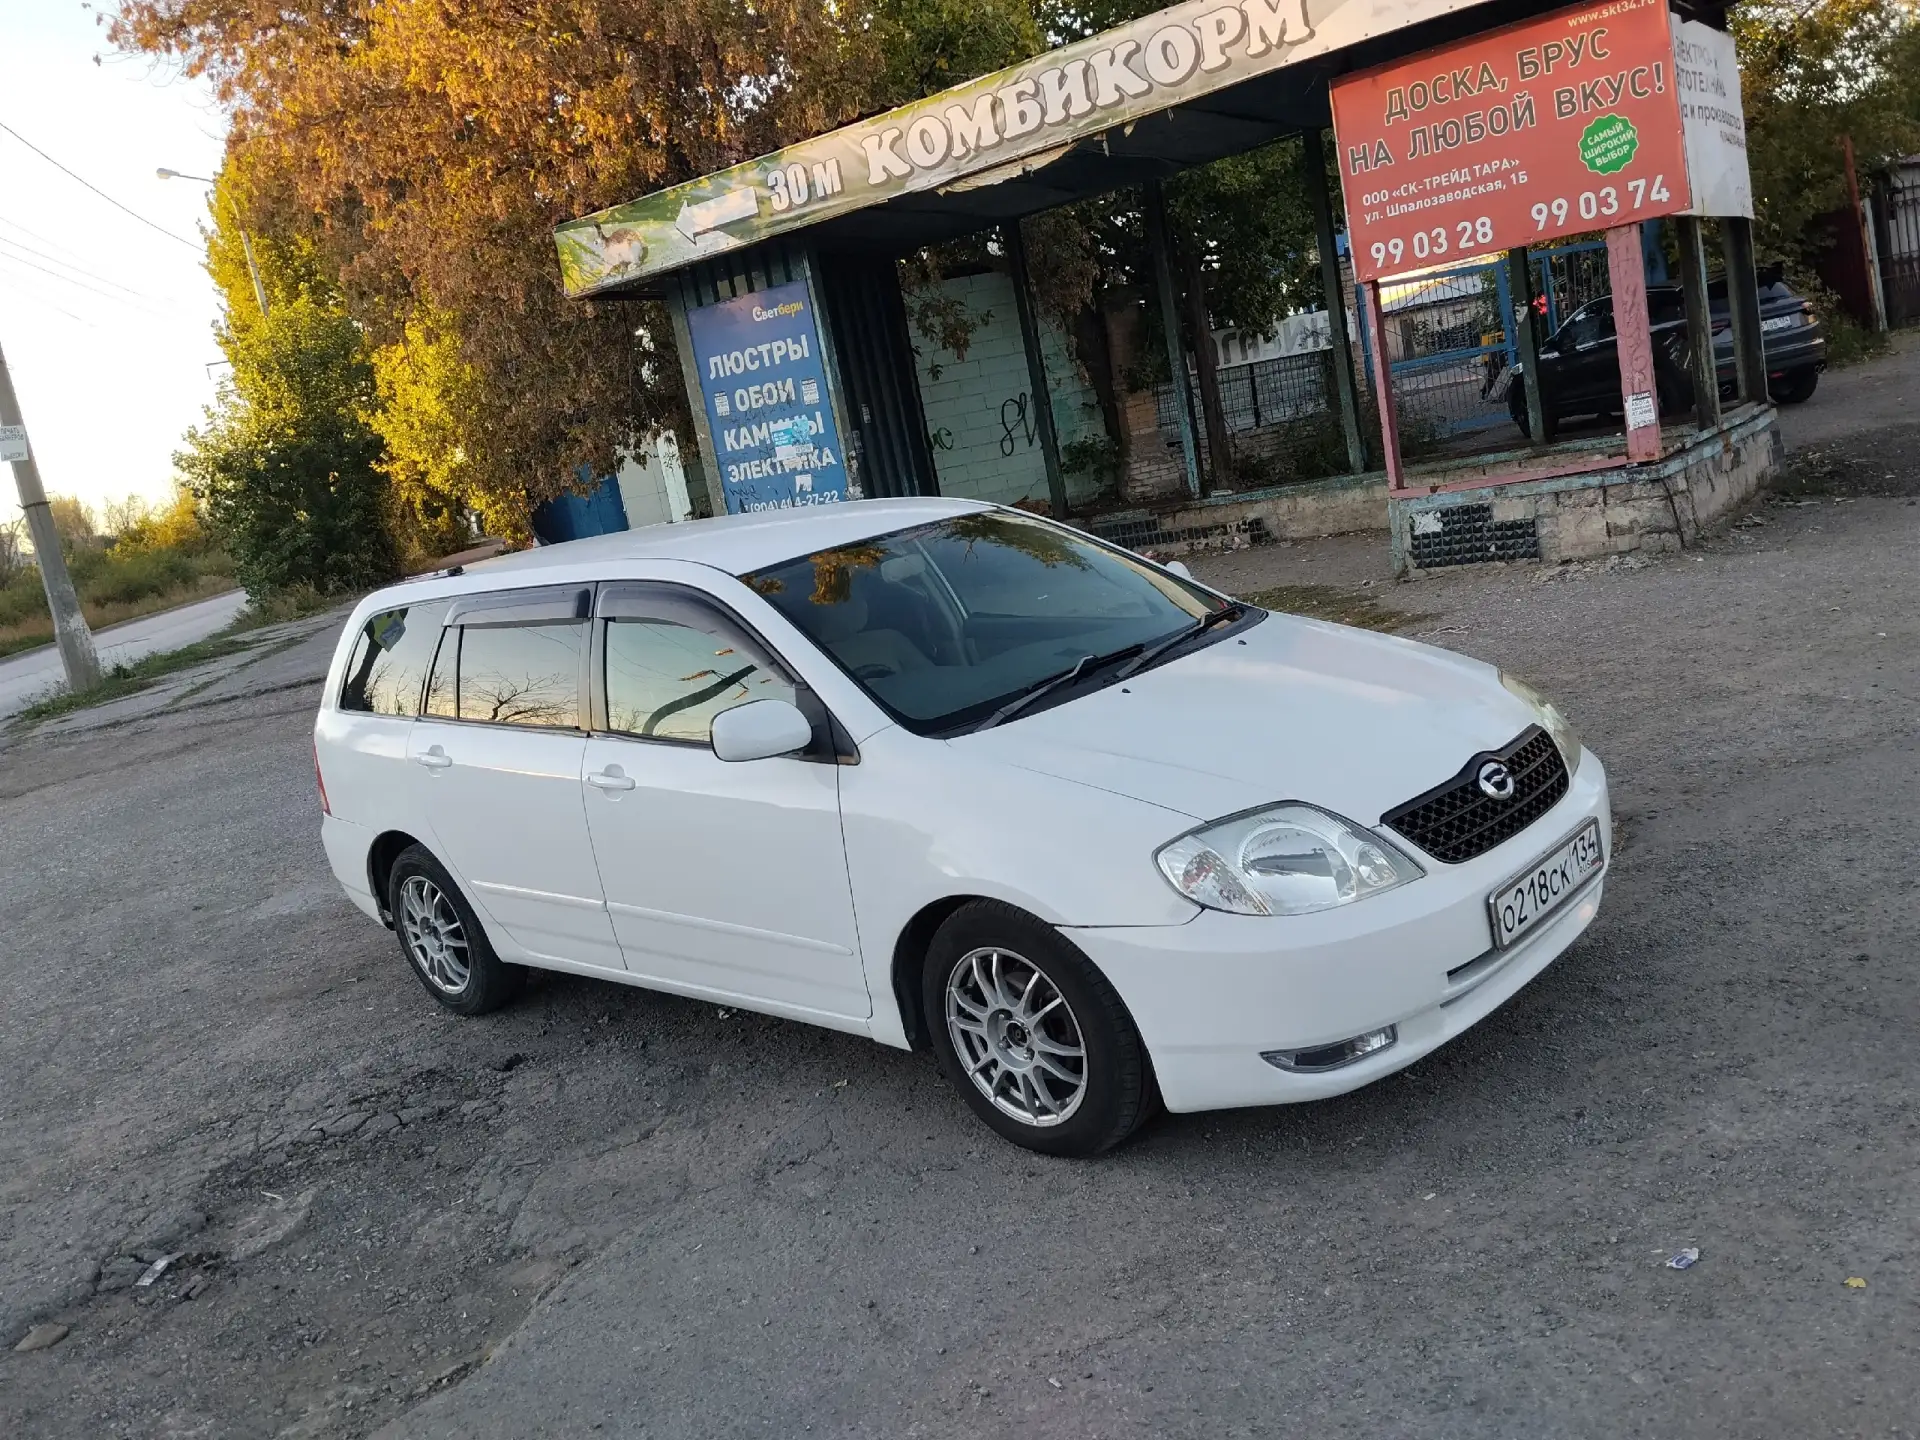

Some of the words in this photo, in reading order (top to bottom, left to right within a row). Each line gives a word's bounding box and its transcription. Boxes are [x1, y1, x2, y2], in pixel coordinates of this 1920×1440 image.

[1384, 62, 1508, 125] ДОСКА,
[1516, 28, 1611, 81] БРУС
[767, 162, 808, 213] 30
[861, 0, 1316, 186] КОМБИКОРМ
[1348, 138, 1395, 176] НА
[1407, 91, 1537, 160] ЛЮБОЙ
[1554, 62, 1666, 119] ВКУС!
[1583, 129, 1634, 160] ШИРОКИЙ
[1587, 121, 1624, 146] САМЫЙ
[1595, 144, 1630, 167] ВЫБОР
[1362, 189, 1389, 207] ООО
[1391, 171, 1471, 198] «СК-ТРЕЙД
[1473, 158, 1520, 179] ТАРА»
[1364, 209, 1384, 226] ул.
[1386, 178, 1507, 218] Шпалозаводская,
[1510, 170, 1528, 186] 1Б
[1531, 197, 1569, 232] 99
[1578, 186, 1619, 220] 03
[1627, 174, 1670, 209] 74
[1370, 237, 1404, 269] 99
[1412, 226, 1448, 259] 03
[1456, 216, 1494, 249] 28
[752, 300, 804, 322] Светбери
[708, 334, 810, 380] ЛЮСТРЫ
[734, 377, 796, 412] ОБОИ
[1572, 828, 1596, 867] 134
[1578, 859, 1592, 877] RUS
